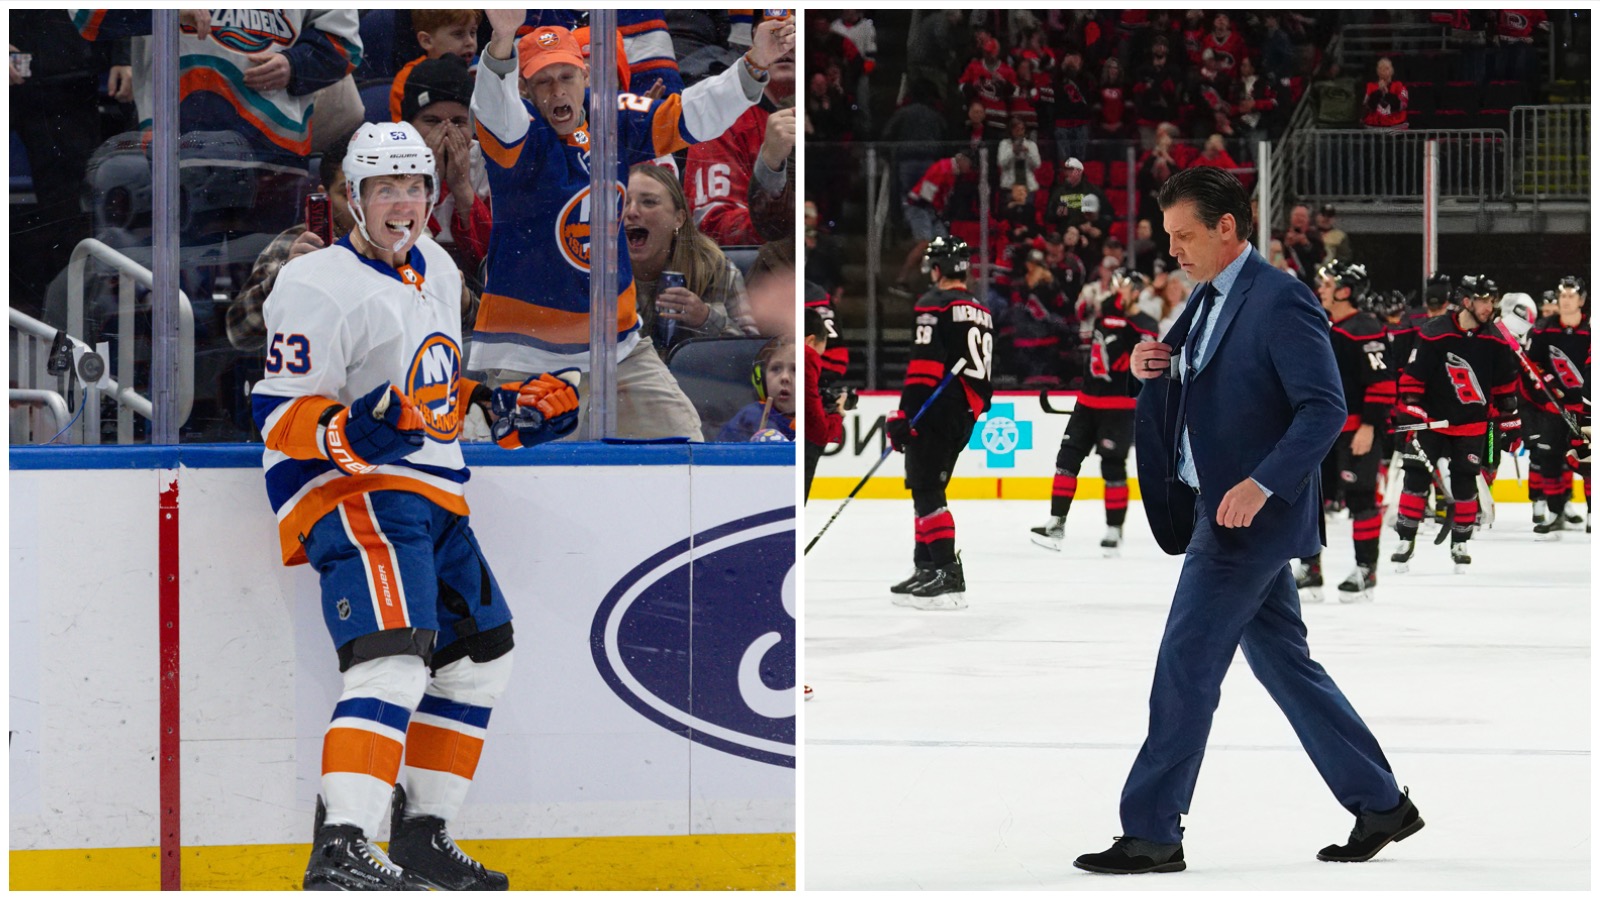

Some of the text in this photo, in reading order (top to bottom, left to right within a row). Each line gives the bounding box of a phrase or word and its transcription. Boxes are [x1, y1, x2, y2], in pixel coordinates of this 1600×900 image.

[210, 9, 293, 39] LANDERS
[390, 131, 407, 140] 53
[694, 163, 730, 206] 16
[266, 332, 312, 375] 53
[421, 344, 456, 390] NY
[378, 564, 393, 607] BAUER
